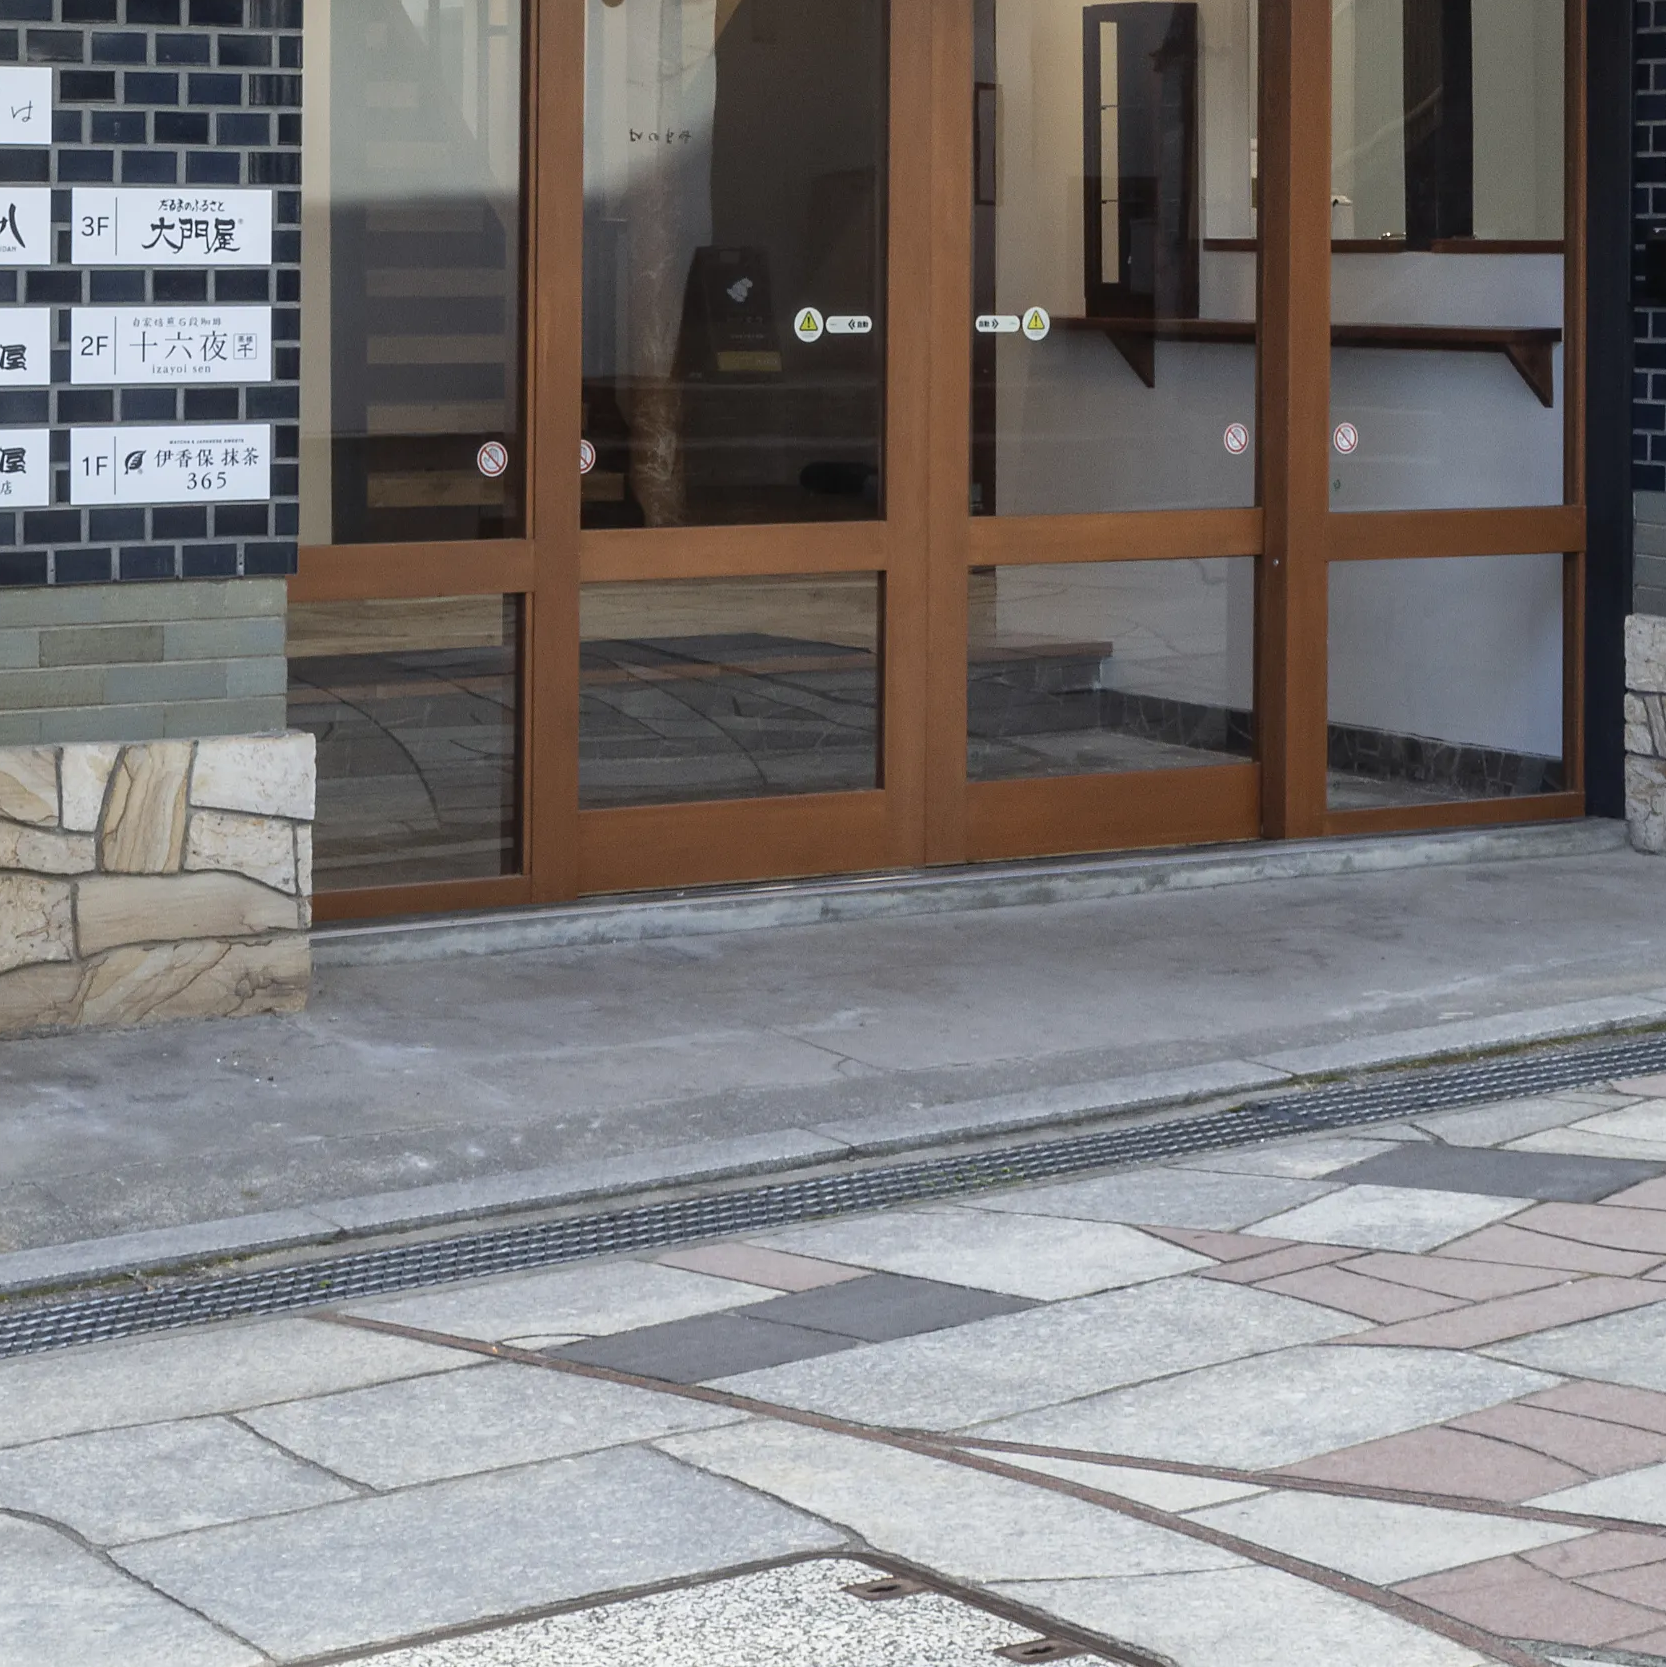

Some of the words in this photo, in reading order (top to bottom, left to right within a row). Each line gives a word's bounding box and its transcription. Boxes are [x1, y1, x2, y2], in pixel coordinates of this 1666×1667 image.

[82, 217, 109, 236] 3F
[142, 217, 241, 254] 大門屋
[81, 336, 108, 355] 2F
[130, 331, 227, 362] 十六夜
[153, 364, 186, 375] izayoi
[83, 456, 108, 476] 1F
[156, 449, 213, 468] 伊香保
[221, 447, 259, 466] 抹茶
[187, 472, 226, 489] 365
